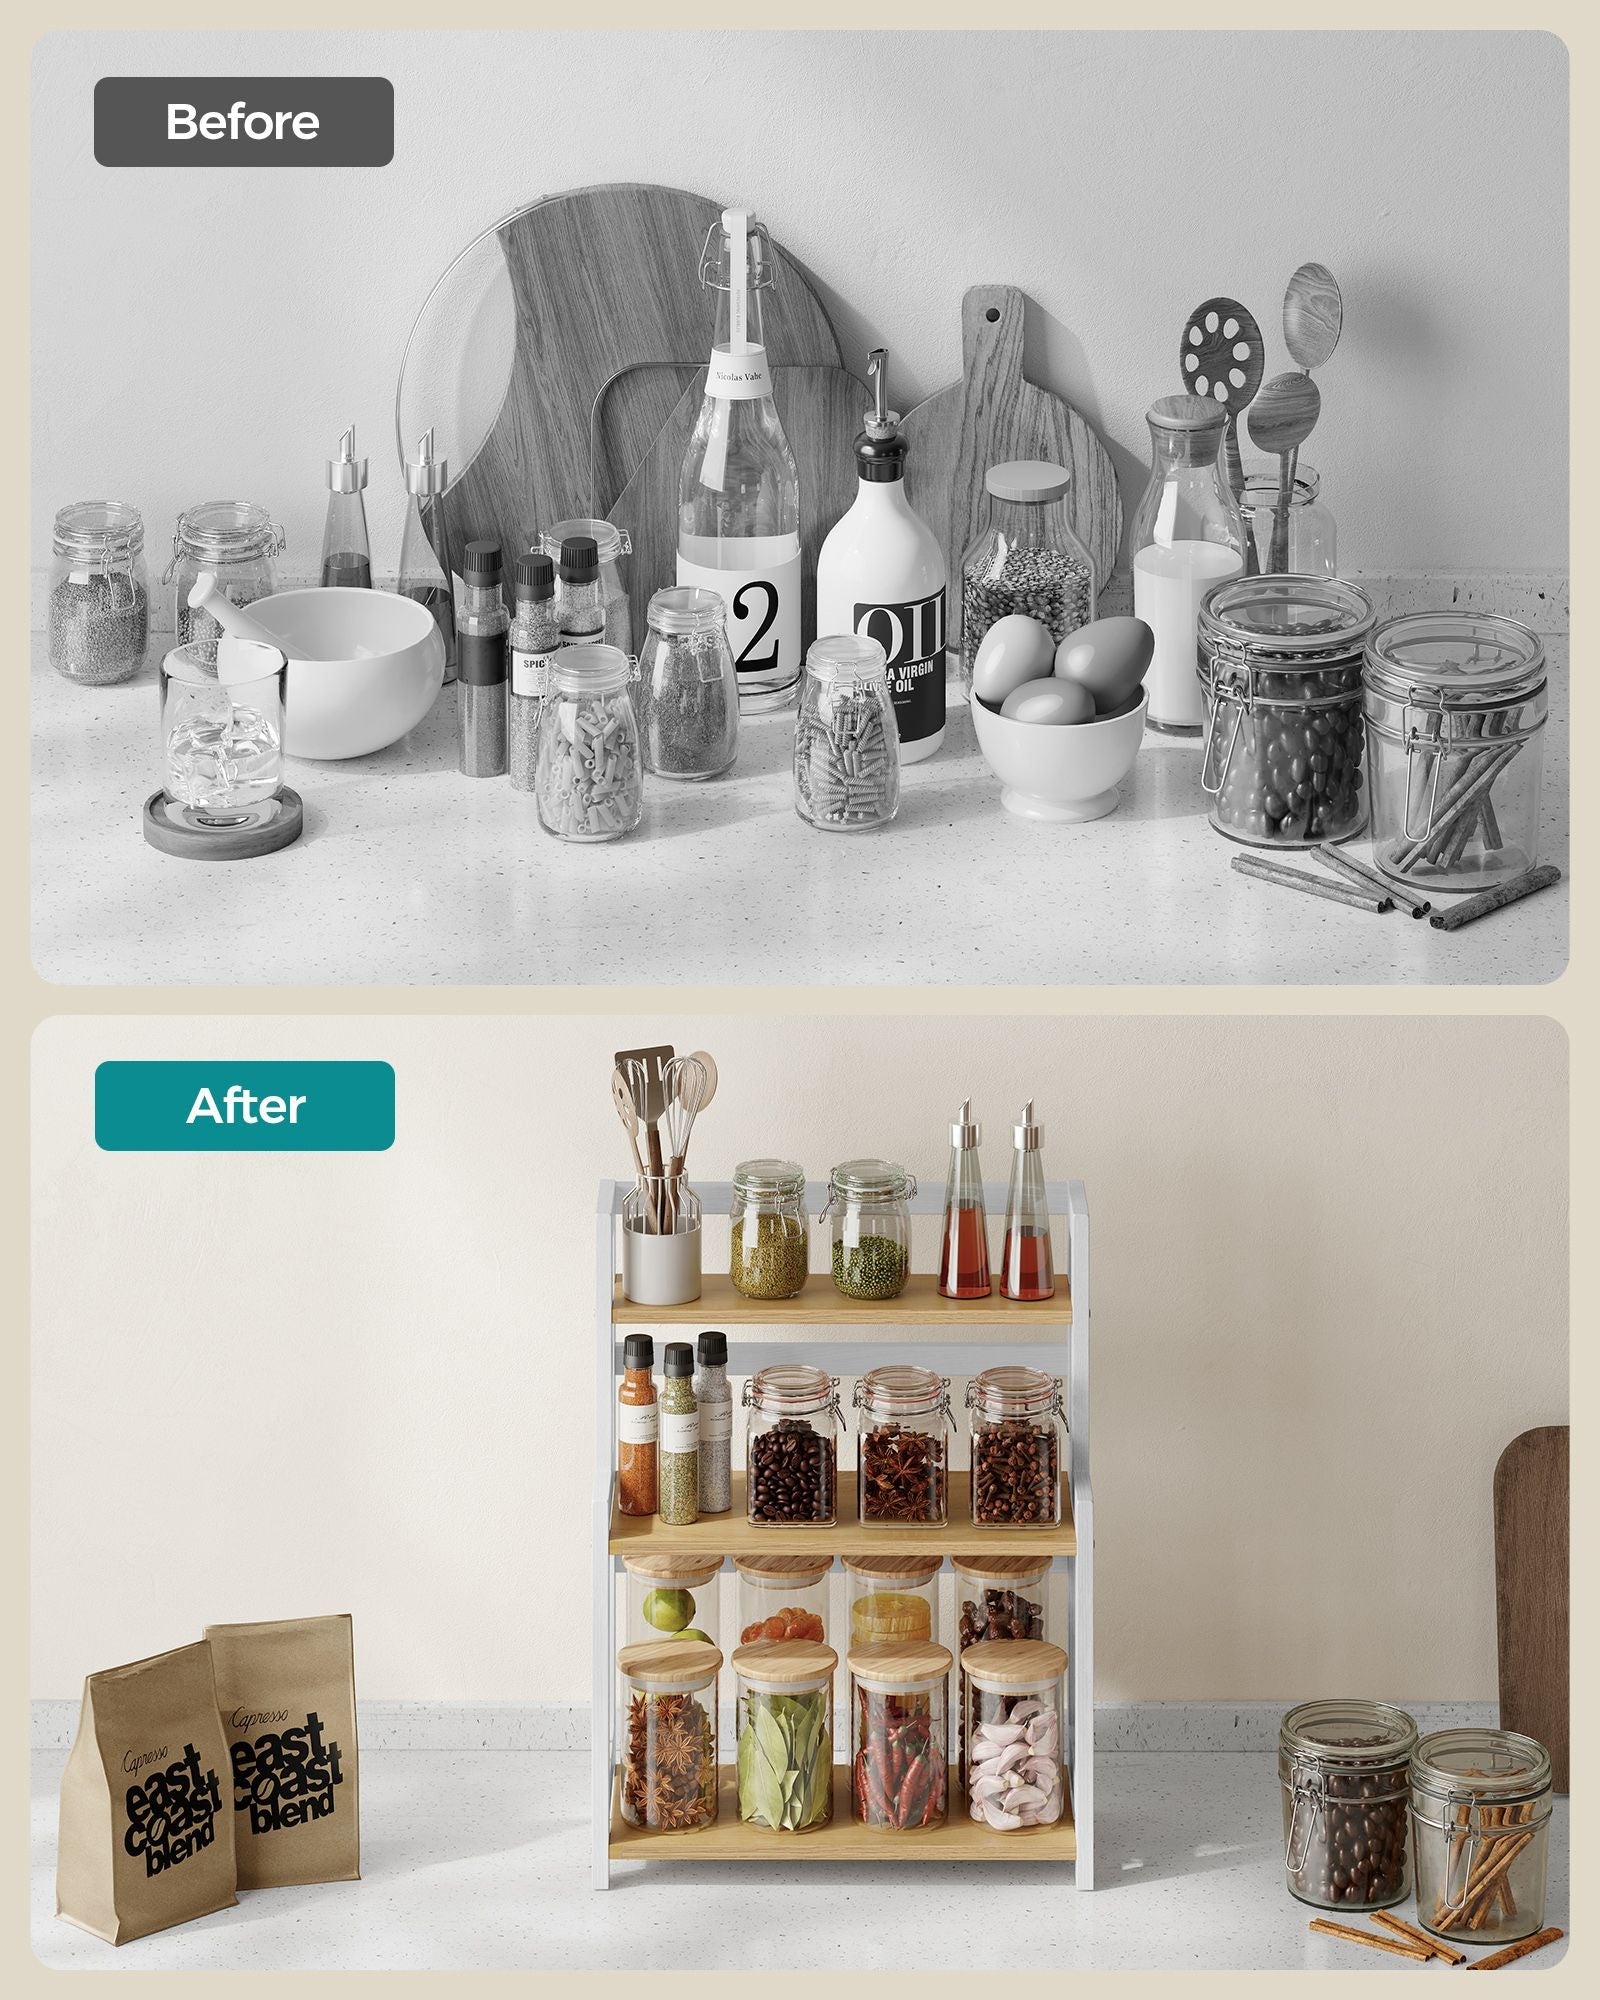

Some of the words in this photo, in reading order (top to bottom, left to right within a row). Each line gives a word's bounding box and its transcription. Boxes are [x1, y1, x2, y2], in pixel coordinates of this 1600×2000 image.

[733, 581, 779, 672] 2
[523, 658, 548, 669] SPIC
[896, 679, 914, 693] OIL
[899, 659, 934, 680] VIRGIN
[227, 1706, 289, 1734] Capresso
[230, 1712, 326, 1777] east
[121, 1746, 168, 1777] Capresso
[126, 1743, 206, 1824] east
[233, 1741, 343, 1811] coast
[124, 1769, 222, 1857] coast
[250, 1783, 334, 1835] blend
[145, 1812, 215, 1878] blend
